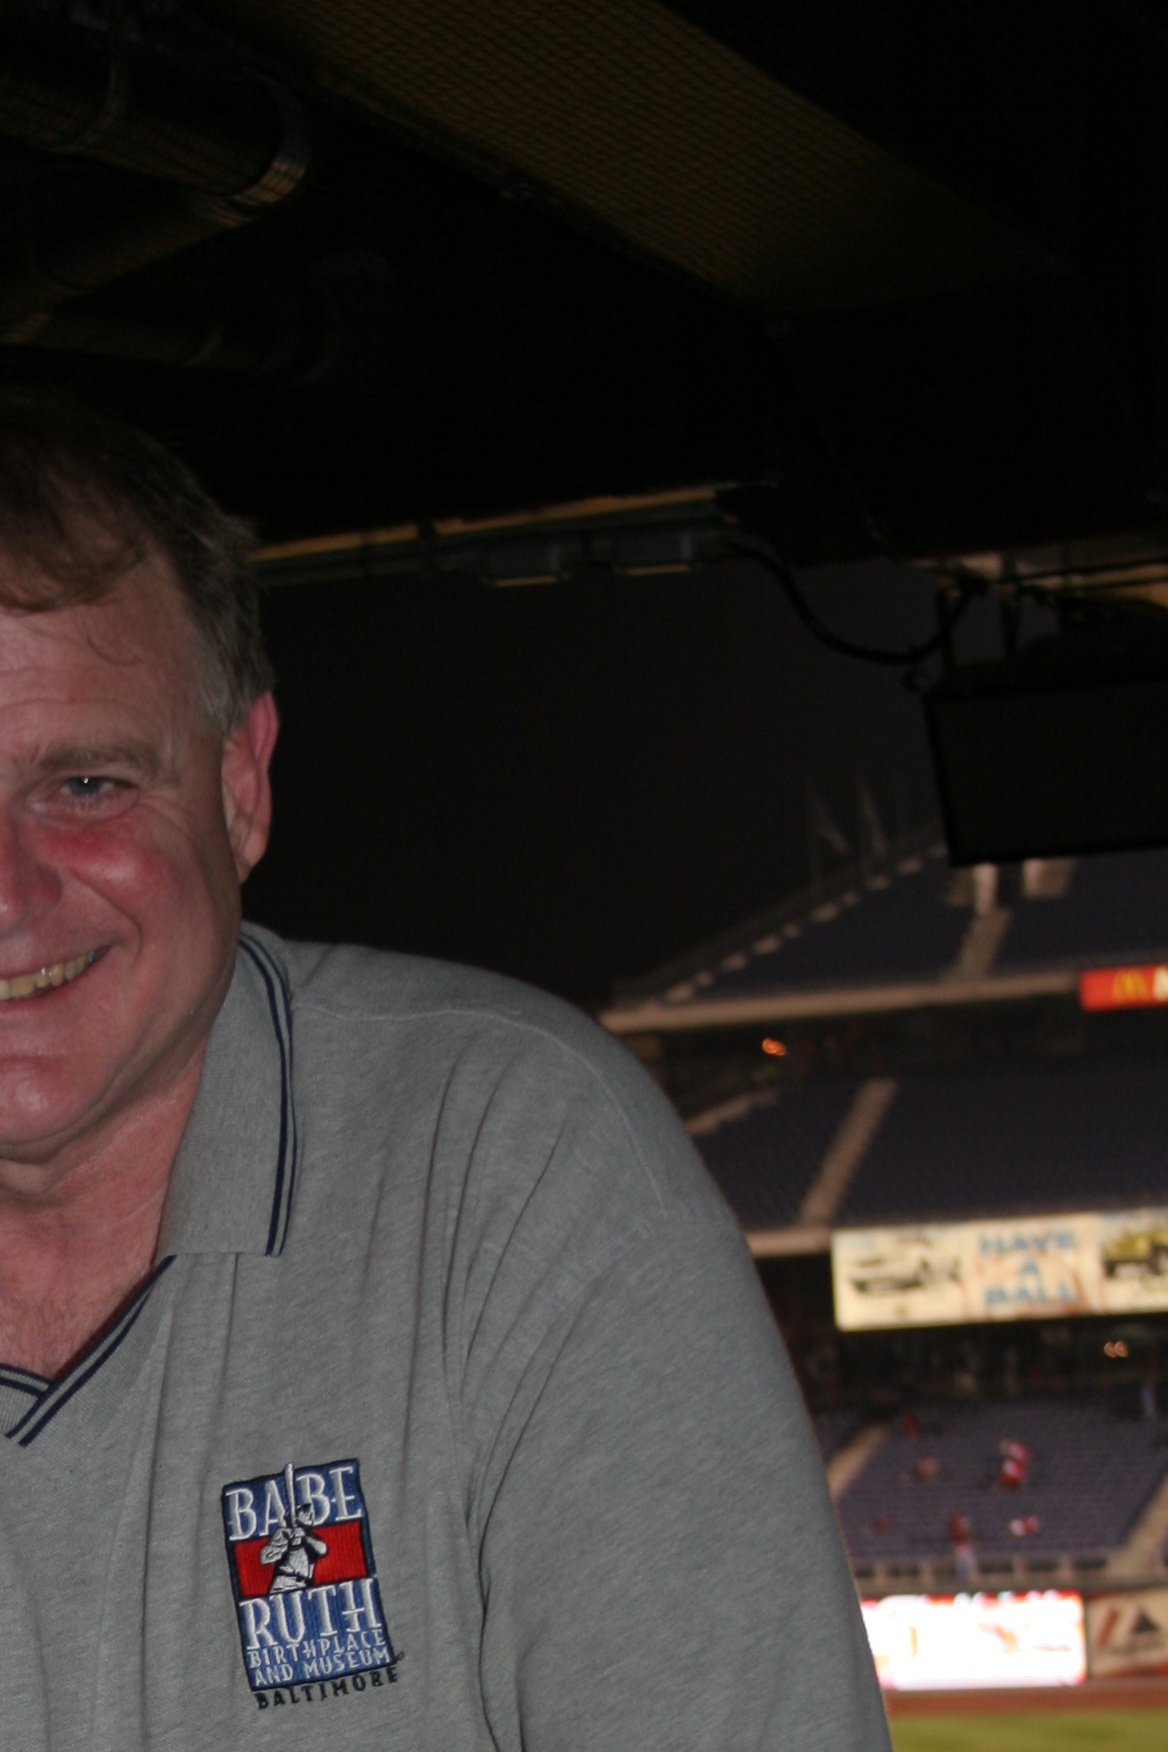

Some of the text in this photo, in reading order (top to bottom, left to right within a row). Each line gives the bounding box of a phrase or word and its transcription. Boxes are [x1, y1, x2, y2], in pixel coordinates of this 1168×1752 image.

[225, 1466, 363, 1541] BABE
[239, 1576, 382, 1650] RUTH
[247, 1629, 386, 1669] BIRTHPLACE
[254, 1646, 391, 1687] AND MUSEUM
[254, 1666, 398, 1710] BALTIMORE
